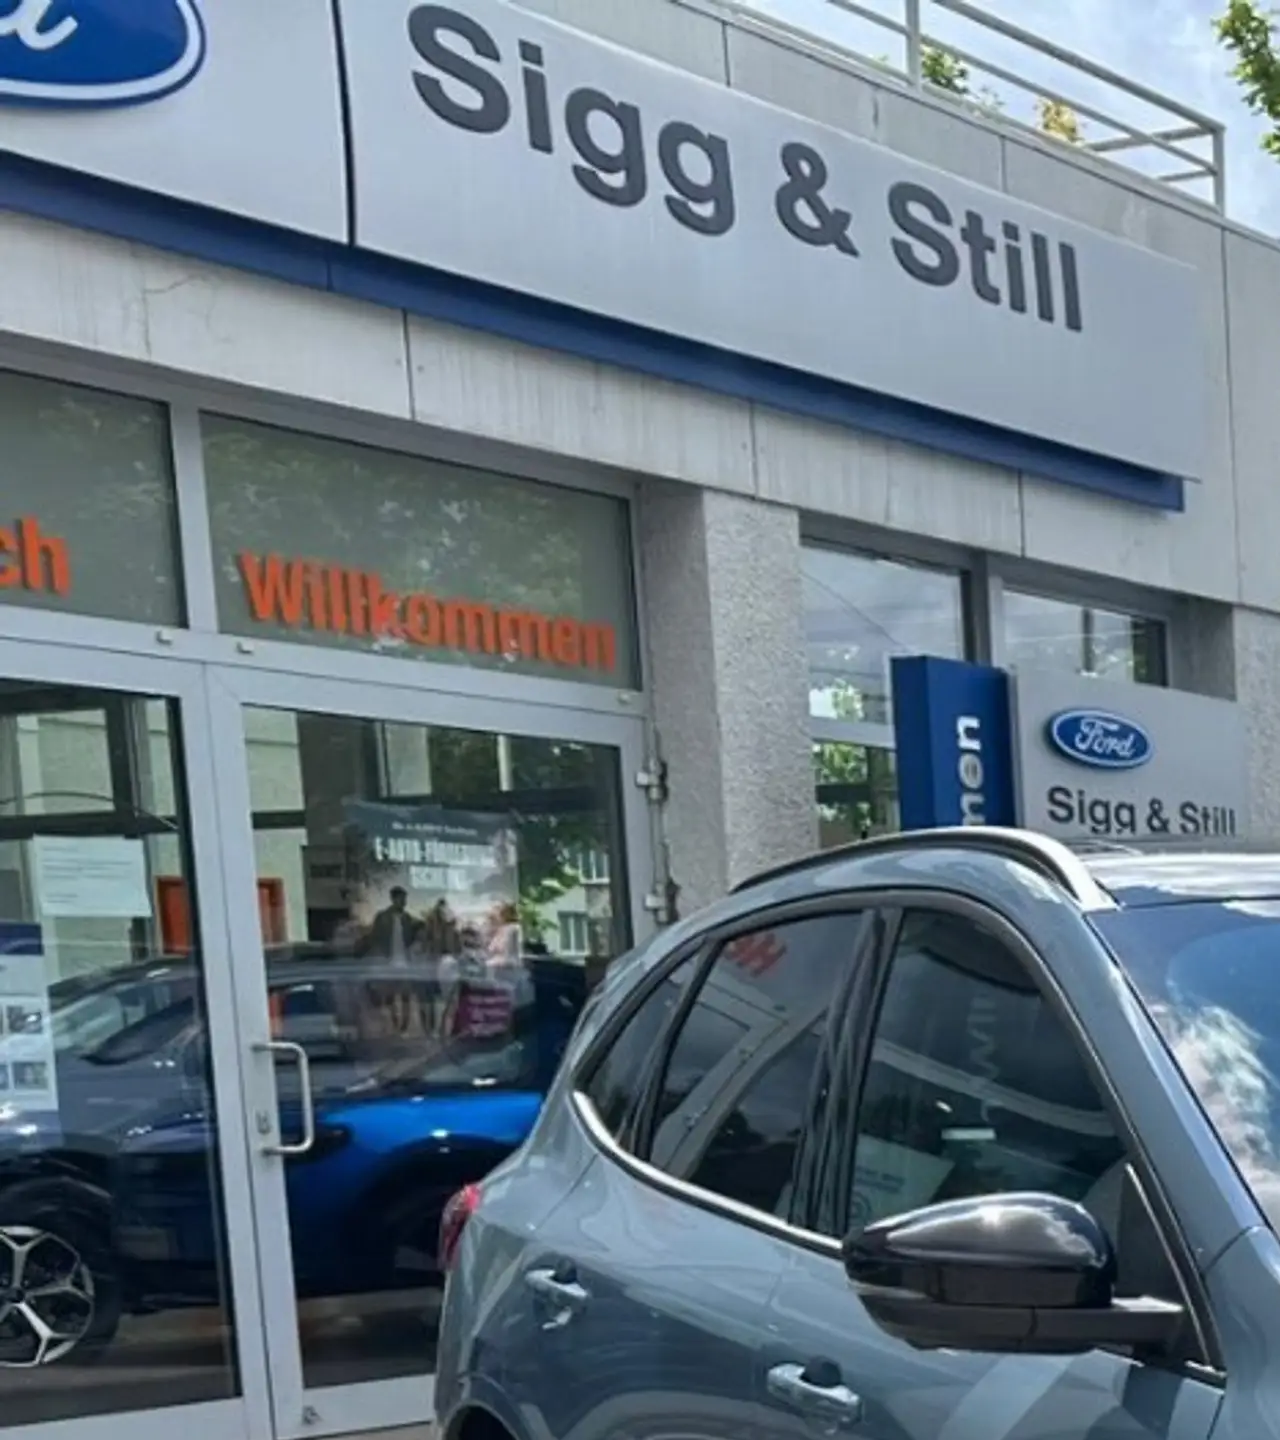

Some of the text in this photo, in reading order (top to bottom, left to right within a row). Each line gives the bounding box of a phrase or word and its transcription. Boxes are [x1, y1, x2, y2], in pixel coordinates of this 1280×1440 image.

[407, 4, 1083, 332] Sigg & Still
[239, 549, 616, 673] Willkommen
[1074, 717, 1137, 758] Ford
[1047, 785, 1236, 837] Sigg & Still
